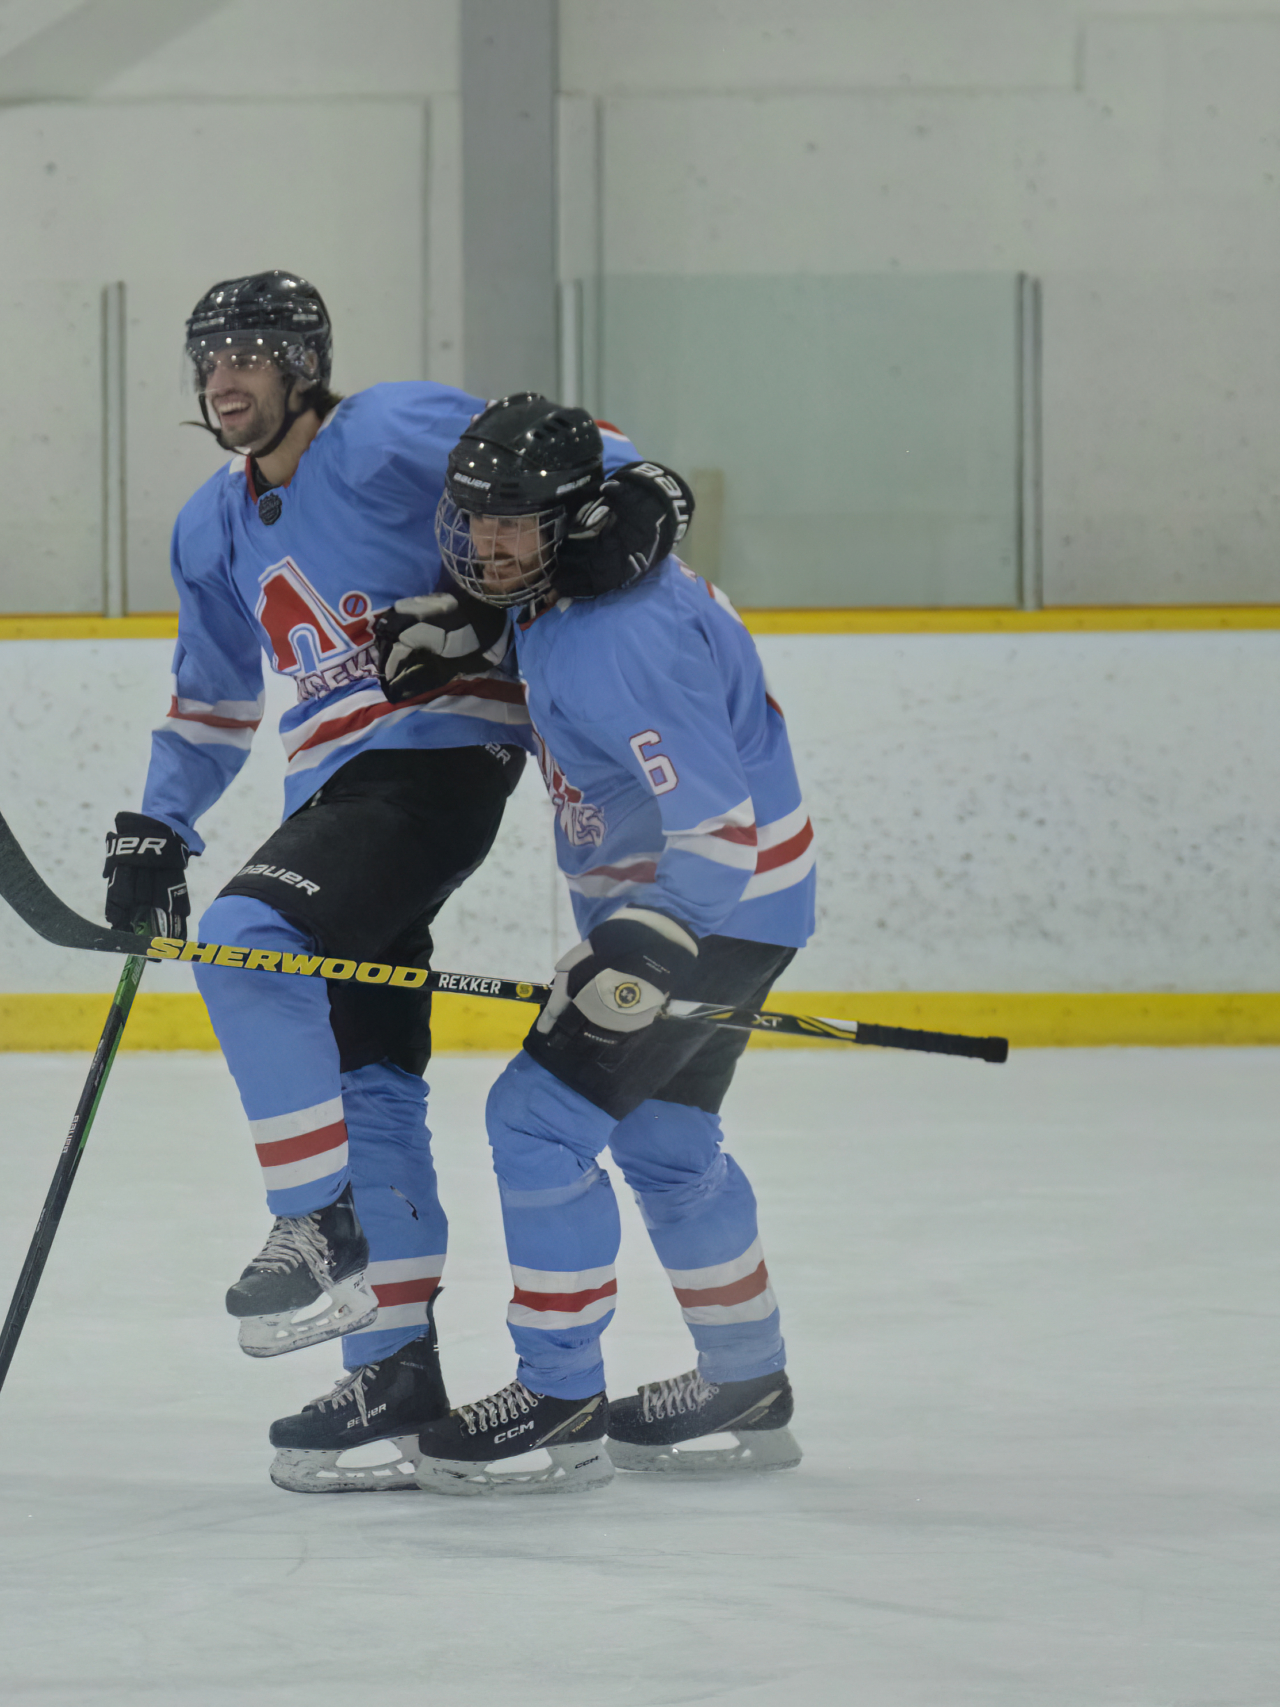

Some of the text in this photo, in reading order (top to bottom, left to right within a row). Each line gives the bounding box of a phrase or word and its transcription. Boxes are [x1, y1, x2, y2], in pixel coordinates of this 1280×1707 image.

[628, 728, 679, 796] 6
[146, 936, 429, 988] SHERWOOD
[439, 973, 502, 995] REKKER
[494, 1420, 535, 1444] CCM
